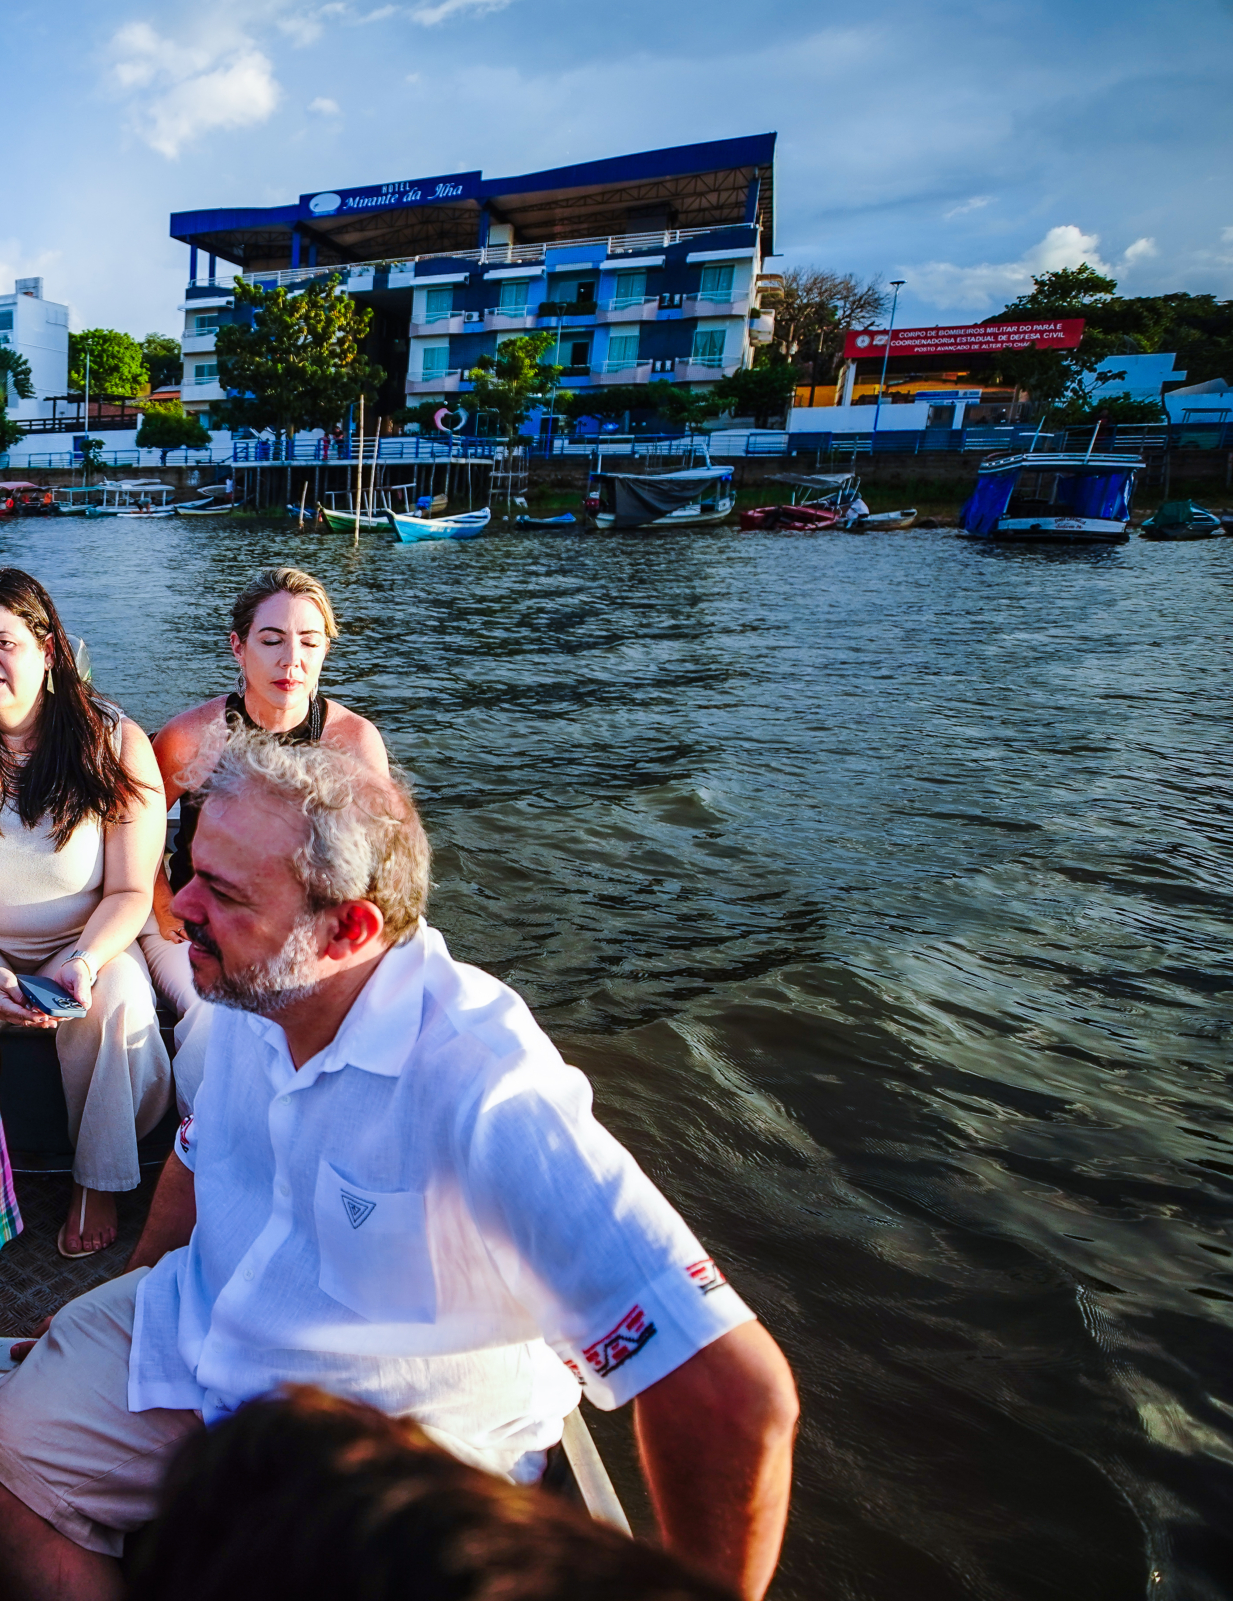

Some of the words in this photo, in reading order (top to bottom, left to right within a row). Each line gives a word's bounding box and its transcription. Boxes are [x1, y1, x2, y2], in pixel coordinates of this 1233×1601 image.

[382, 182, 410, 193] HOTEL
[343, 194, 398, 208] Mirante
[402, 187, 421, 202] da
[427, 183, 463, 200] Ilha
[1033, 322, 1054, 330] PARÁ
[890, 338, 954, 346] COORDENADORIA
